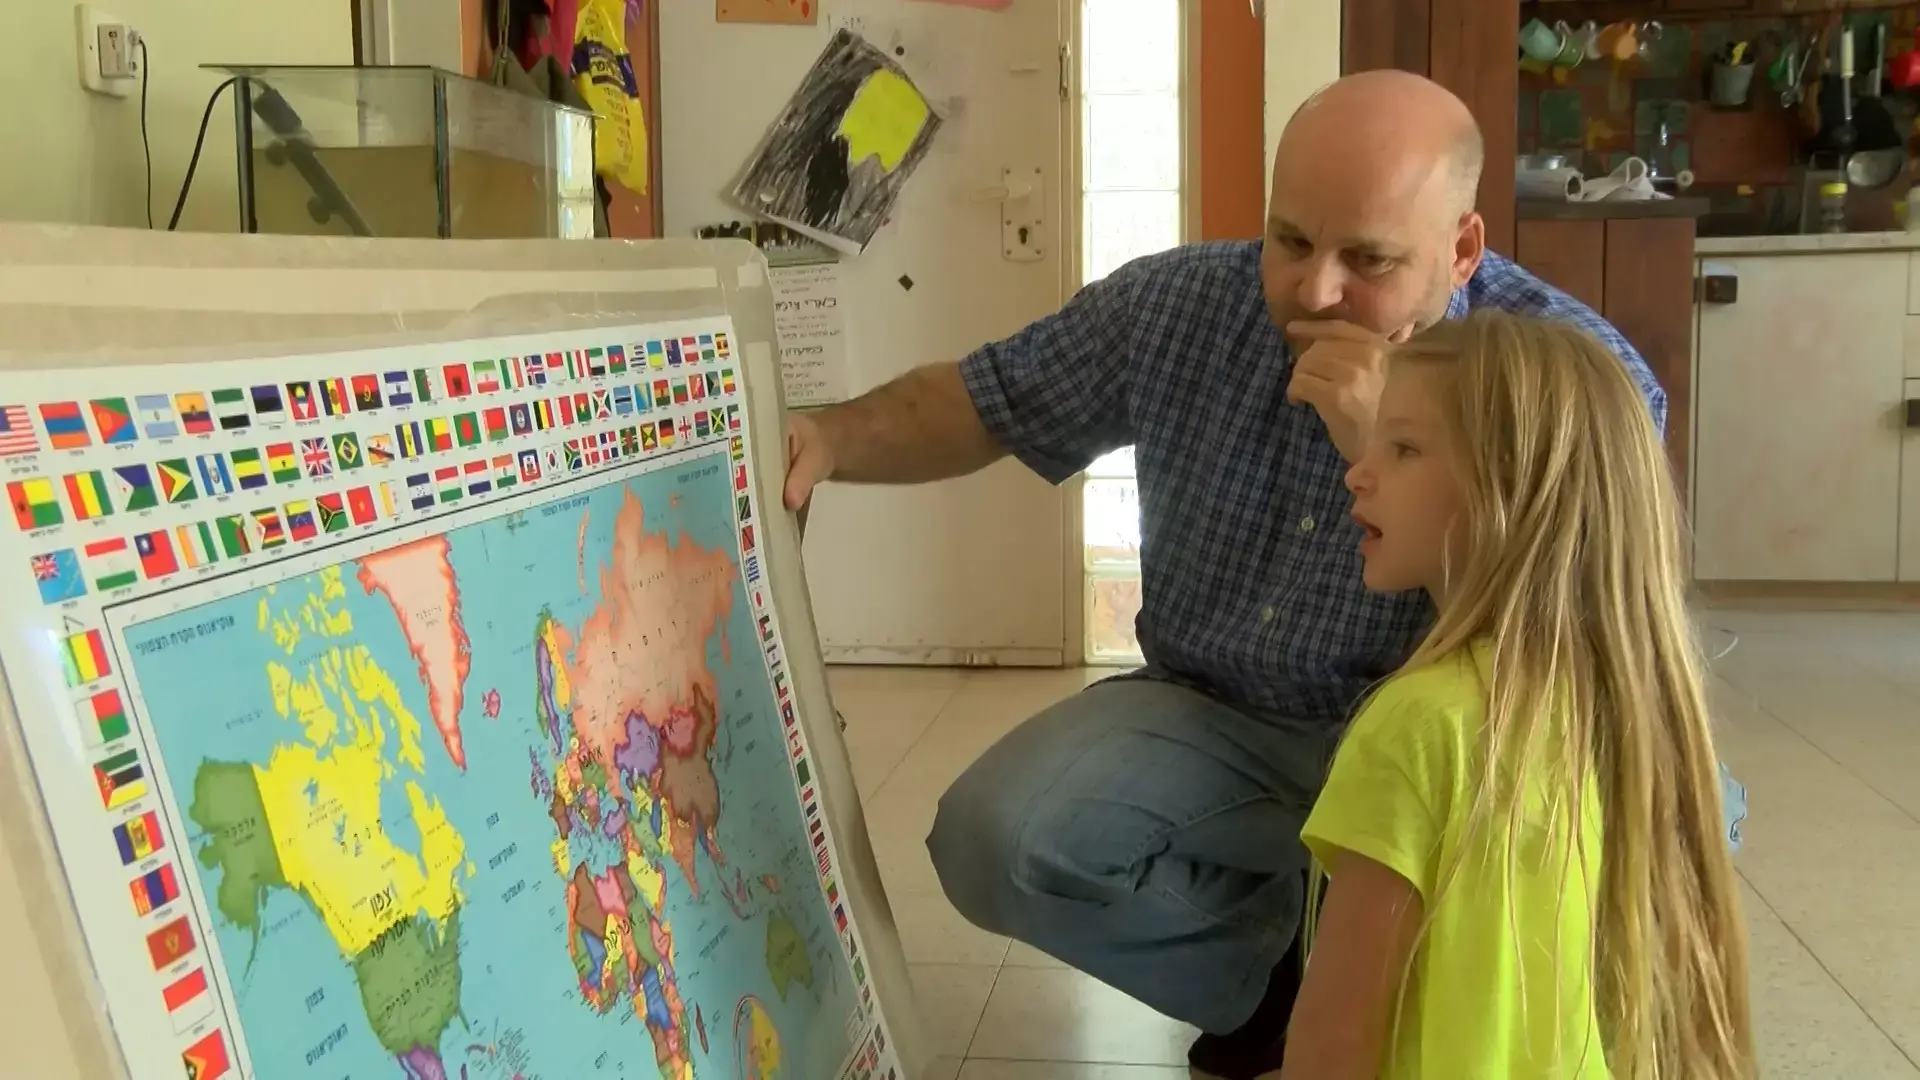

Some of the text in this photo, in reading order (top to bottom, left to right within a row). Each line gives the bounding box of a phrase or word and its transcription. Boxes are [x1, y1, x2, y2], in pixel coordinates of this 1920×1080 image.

[369, 886, 393, 919] צפון
[369, 913, 412, 961] אמריקה
[305, 987, 325, 1014] צפון
[305, 1022, 349, 1067] האוקיאנוס
